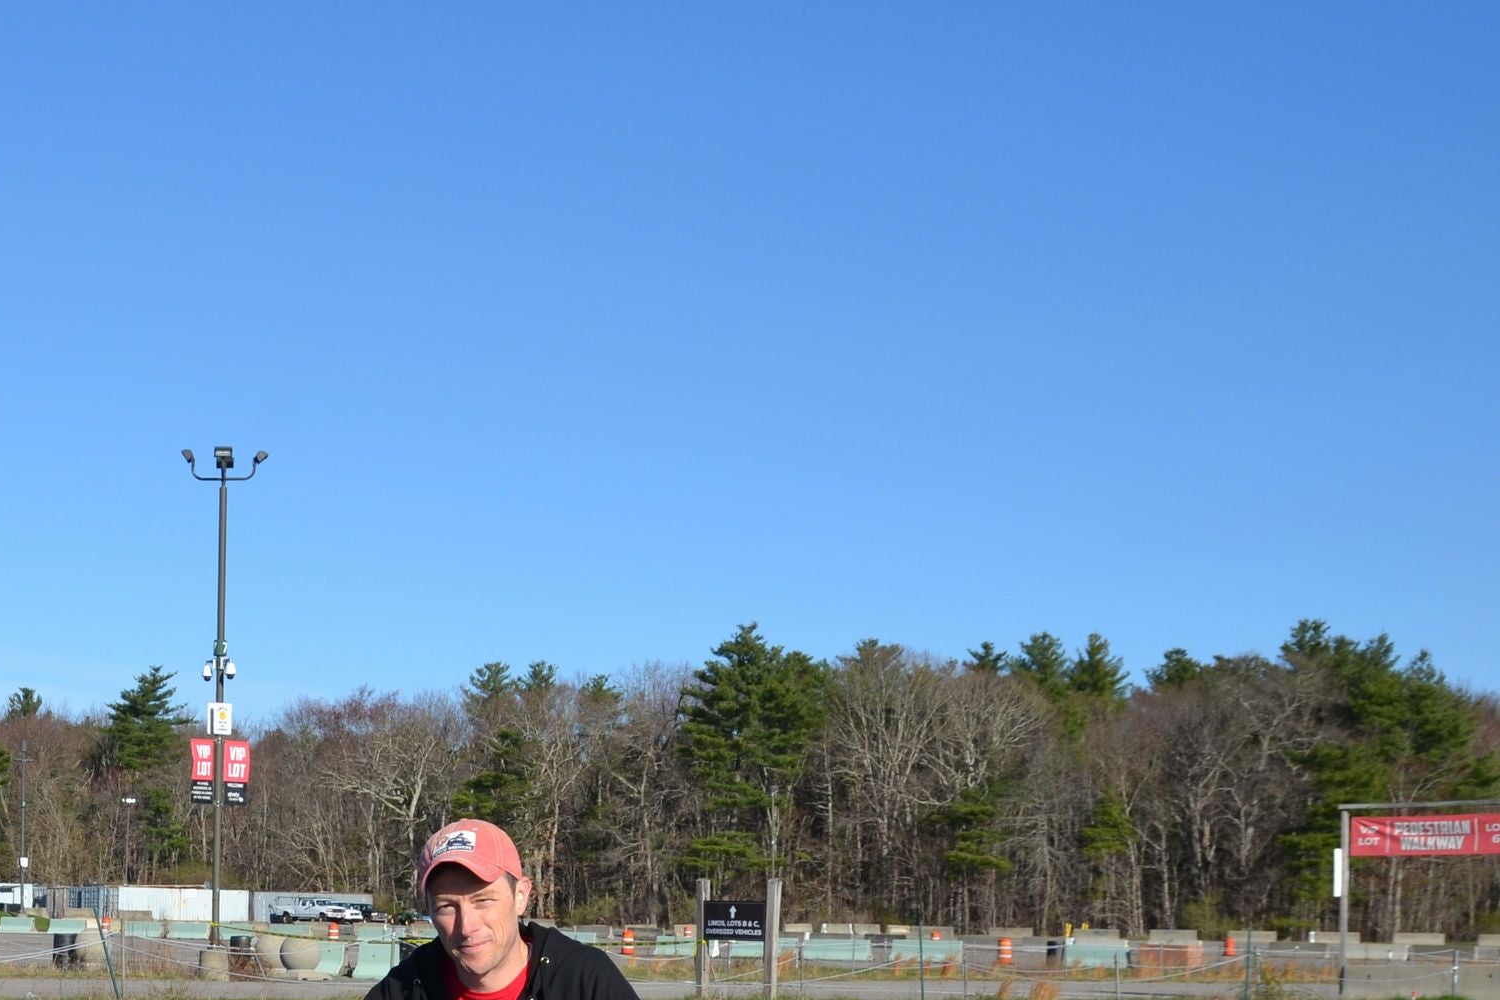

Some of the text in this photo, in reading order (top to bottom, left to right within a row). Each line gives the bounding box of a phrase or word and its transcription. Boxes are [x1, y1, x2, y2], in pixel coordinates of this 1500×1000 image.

[196, 744, 211, 759] VIP
[229, 746, 246, 761] VIP
[196, 761, 211, 776] LOT
[228, 763, 246, 778] LOT
[1394, 820, 1470, 835] PEDESTRIAN
[1485, 823, 1500, 832] LO
[1358, 837, 1380, 846] LOT
[1401, 835, 1465, 850] WALKWAY
